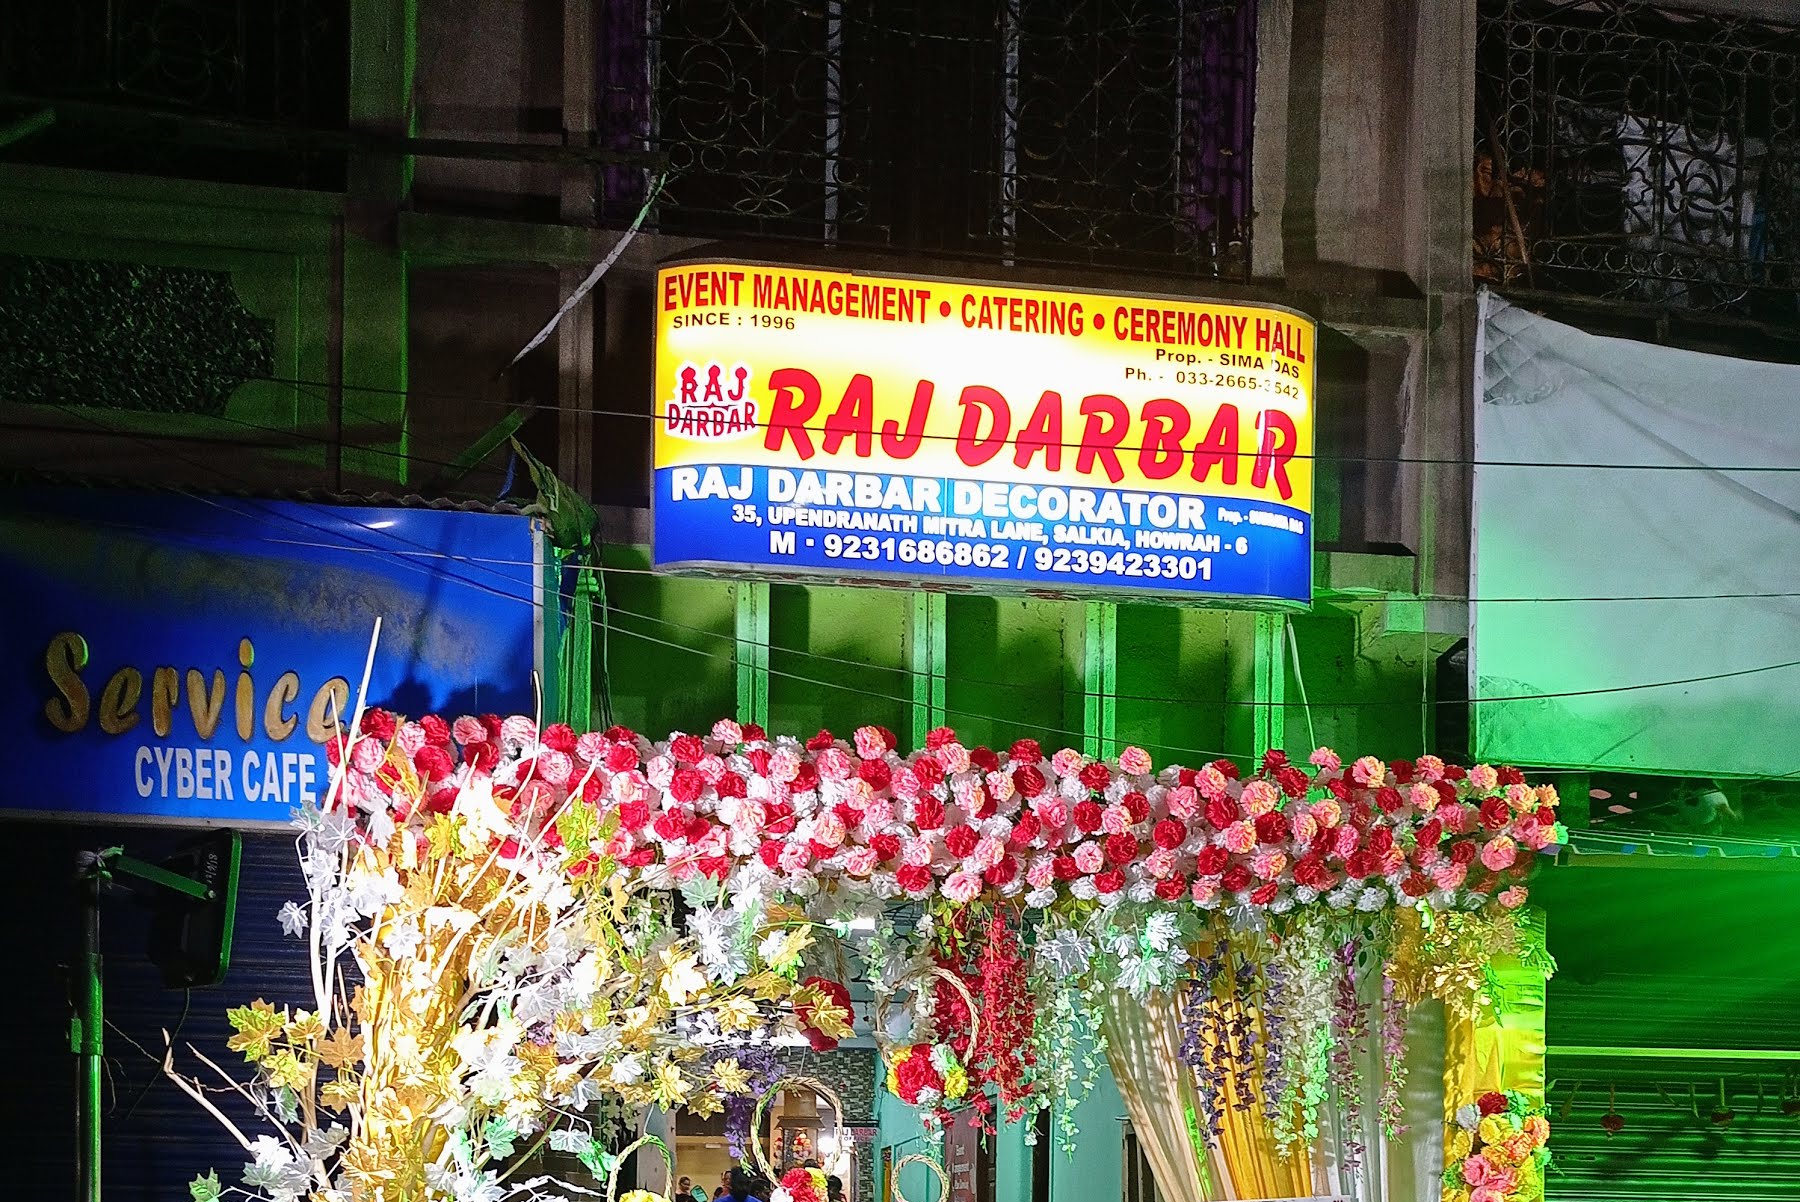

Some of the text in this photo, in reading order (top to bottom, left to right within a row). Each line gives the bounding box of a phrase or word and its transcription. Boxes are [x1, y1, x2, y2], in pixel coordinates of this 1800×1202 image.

[664, 271, 1306, 364] EVENT MANAGEMENT CATERING CEREMONY HALL
[672, 312, 730, 329] SINCE
[750, 313, 796, 330] 1996
[681, 365, 748, 404] RAJ
[1125, 367, 1152, 382] Ph.
[1155, 348, 1202, 365] Prop.
[1219, 353, 1265, 370] SIMA
[668, 401, 757, 437] DARBAR
[763, 368, 1298, 501] RAJ DARBAR
[671, 466, 754, 502] RAJ
[767, 468, 943, 512] DARBAR
[953, 481, 1207, 531] DECORATOR
[731, 503, 763, 527] 35,
[767, 506, 918, 534] UPENDRANATH
[922, 515, 986, 539] MITRA
[990, 519, 1049, 546] LANE,
[1053, 524, 1131, 550] SALKIA,
[1135, 530, 1221, 554] HOWRAH
[1235, 536, 1249, 555] 6
[769, 530, 796, 555] M
[823, 533, 1010, 569] 9231686862
[1034, 547, 1213, 581] 9239423301
[45, 631, 351, 744] Service
[134, 745, 317, 804] CYBER CAFE
